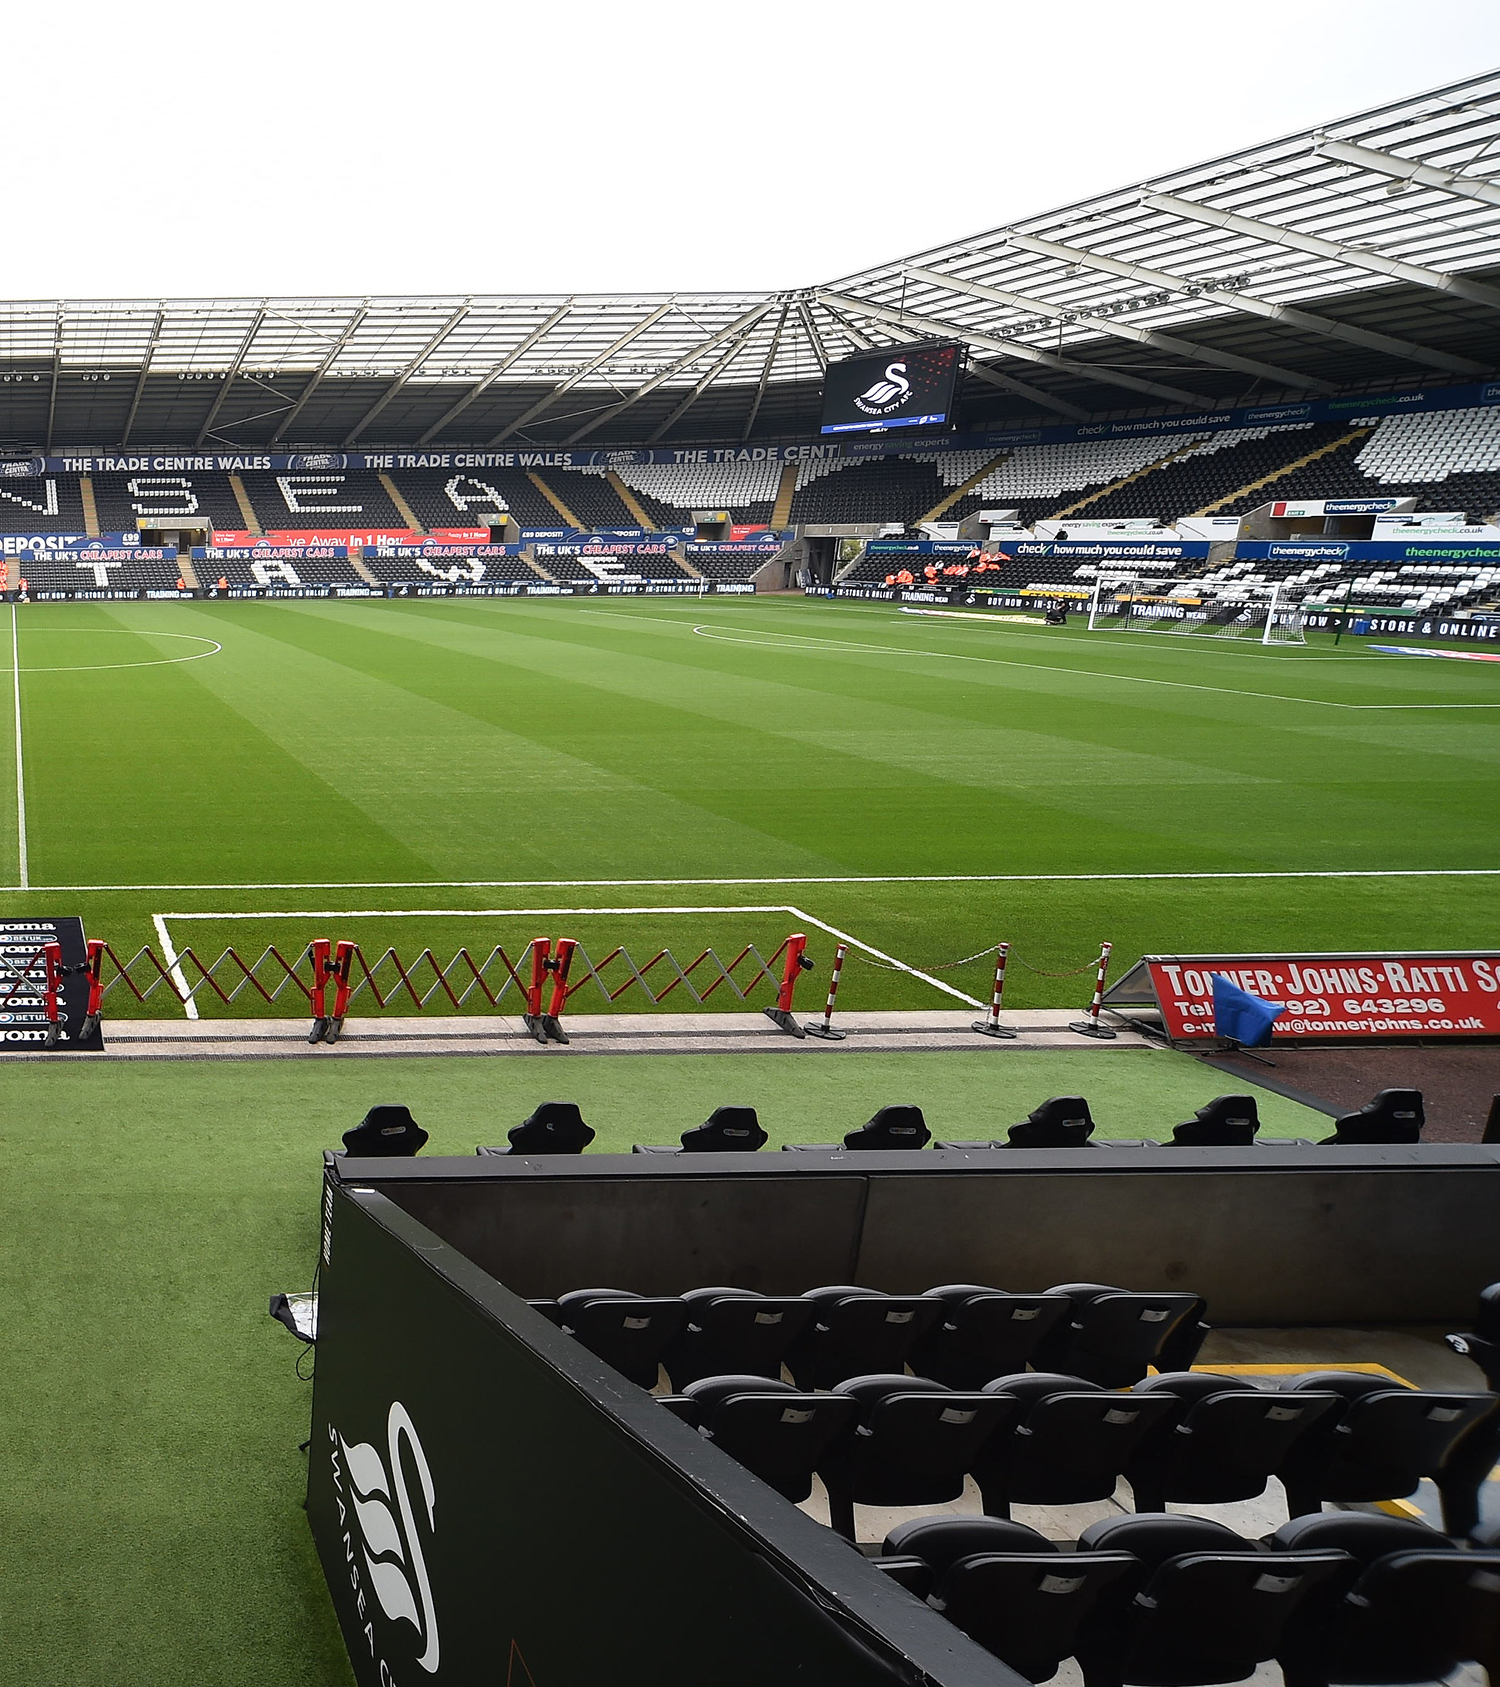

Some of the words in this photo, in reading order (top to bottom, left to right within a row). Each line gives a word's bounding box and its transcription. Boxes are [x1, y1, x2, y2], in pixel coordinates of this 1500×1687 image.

[853, 397, 882, 415] SWANSEA
[883, 401, 899, 413] CITY
[900, 390, 913, 404] AFC
[1328, 392, 1425, 409] theenergycheck.co.uk
[1248, 406, 1308, 421] theenergycheck
[1077, 424, 1103, 436] check
[1112, 423, 1132, 432] how
[1133, 420, 1159, 431] much
[1161, 419, 1179, 429] you
[1180, 415, 1207, 426] could
[1208, 415, 1231, 424] save
[854, 441, 884, 451] energy
[885, 439, 913, 449] saving
[914, 437, 950, 448] experts
[364, 455, 394, 468] THE
[397, 454, 450, 467] TRADE
[454, 453, 514, 467] CENTRE
[518, 452, 572, 466] WALES
[674, 450, 709, 464] THE
[713, 447, 778, 463] TRADE
[783, 444, 838, 460] CENT
[63, 458, 93, 472] THE
[96, 457, 149, 471] TRADE
[153, 457, 214, 471] CENTRE
[215, 456, 271, 470] WALES
[1326, 502, 1391, 512] theenergycheck
[1082, 521, 1100, 529] saving
[1393, 527, 1483, 535] theenergycheck.co.uk
[123, 533, 139, 541] £99
[309, 535, 346, 546] Away
[350, 535, 362, 546] In
[367, 535, 373, 546] 1
[34, 552, 53, 561] THE
[55, 551, 78, 560] UK'S
[80, 550, 132, 560] CHEAPEST
[135, 549, 163, 559] CARS
[205, 549, 224, 558] THE
[226, 549, 249, 558] UK'S
[252, 548, 304, 558] CHEAPEST
[306, 547, 334, 557] CARS
[536, 546, 555, 555] THE
[557, 545, 580, 554] UK'S
[582, 544, 635, 554] CHEAPEST
[636, 544, 666, 553] CARS
[1017, 543, 1046, 555] check
[1053, 544, 1076, 554] how
[1077, 544, 1102, 555] much
[1103, 546, 1122, 556] you
[1123, 544, 1155, 555] could
[1155, 547, 1182, 555] save
[1272, 547, 1342, 557] theenergycheck
[716, 584, 754, 593] TRAINING
[901, 592, 934, 602] TRAINING
[1132, 604, 1184, 618] TRAINING
[1186, 611, 1207, 620] WEAR
[1272, 613, 1295, 625] BUY
[1300, 615, 1328, 627] NOW
[1421, 622, 1431, 634] &
[1439, 623, 1498, 638] ONLINE
[1343, 998, 1446, 1014] 643296
[328, 1423, 374, 1659] SWANSEA
